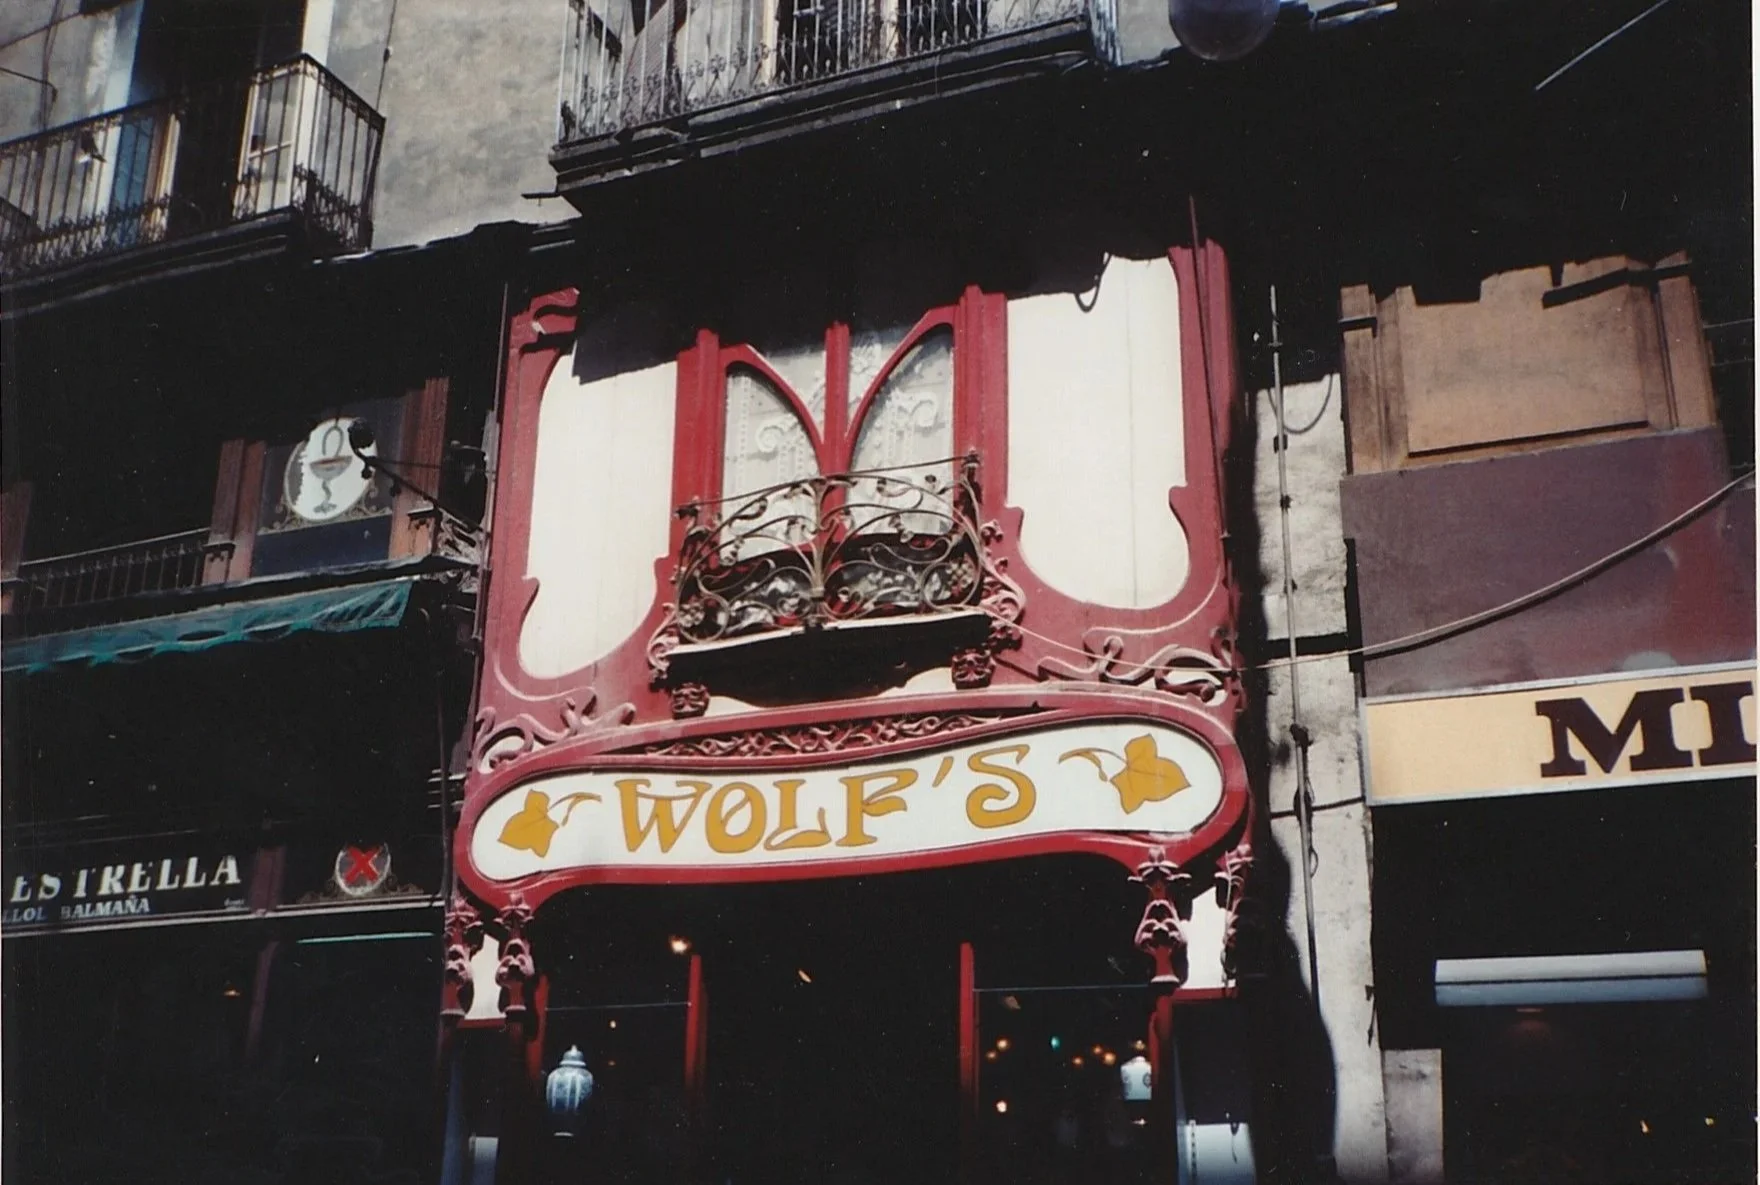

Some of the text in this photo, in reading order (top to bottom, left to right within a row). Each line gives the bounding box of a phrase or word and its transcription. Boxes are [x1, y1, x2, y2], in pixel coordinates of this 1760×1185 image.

[1535, 681, 1757, 777] MI
[613, 744, 1037, 854] WOLF'S
[10, 855, 241, 903] ESTRELLA
[61, 894, 150, 919] BALMAÑA
